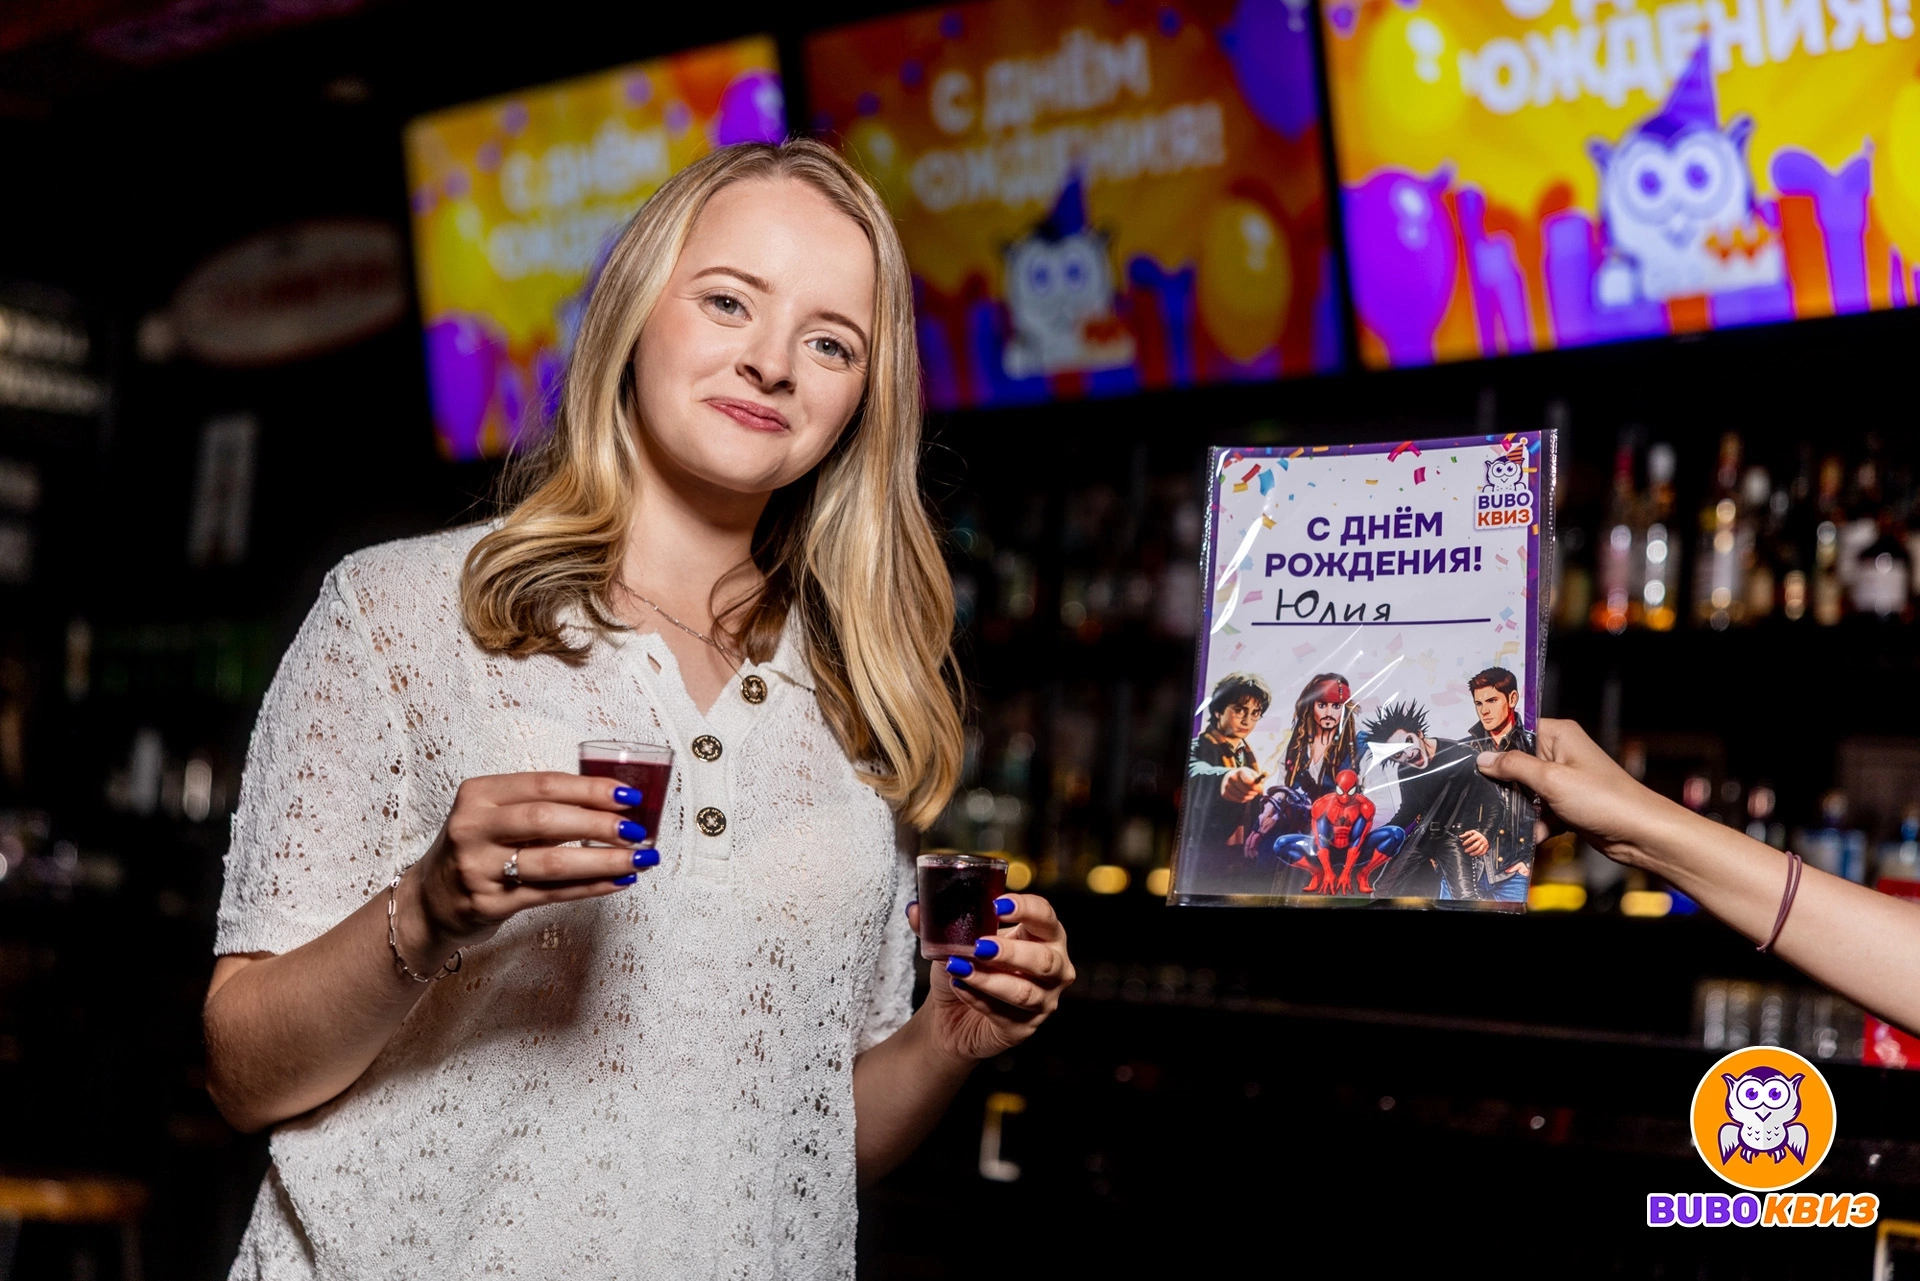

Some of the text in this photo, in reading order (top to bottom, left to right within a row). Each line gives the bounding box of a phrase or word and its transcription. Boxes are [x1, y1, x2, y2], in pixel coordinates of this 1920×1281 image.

[1477, 509, 1530, 527] КВИЗ
[1478, 492, 1531, 510] BUBO
[1307, 506, 1443, 546] С ДНЁМ
[1265, 546, 1482, 582] РОЖДЕНИЯ!
[1276, 588, 1391, 624] Юлия
